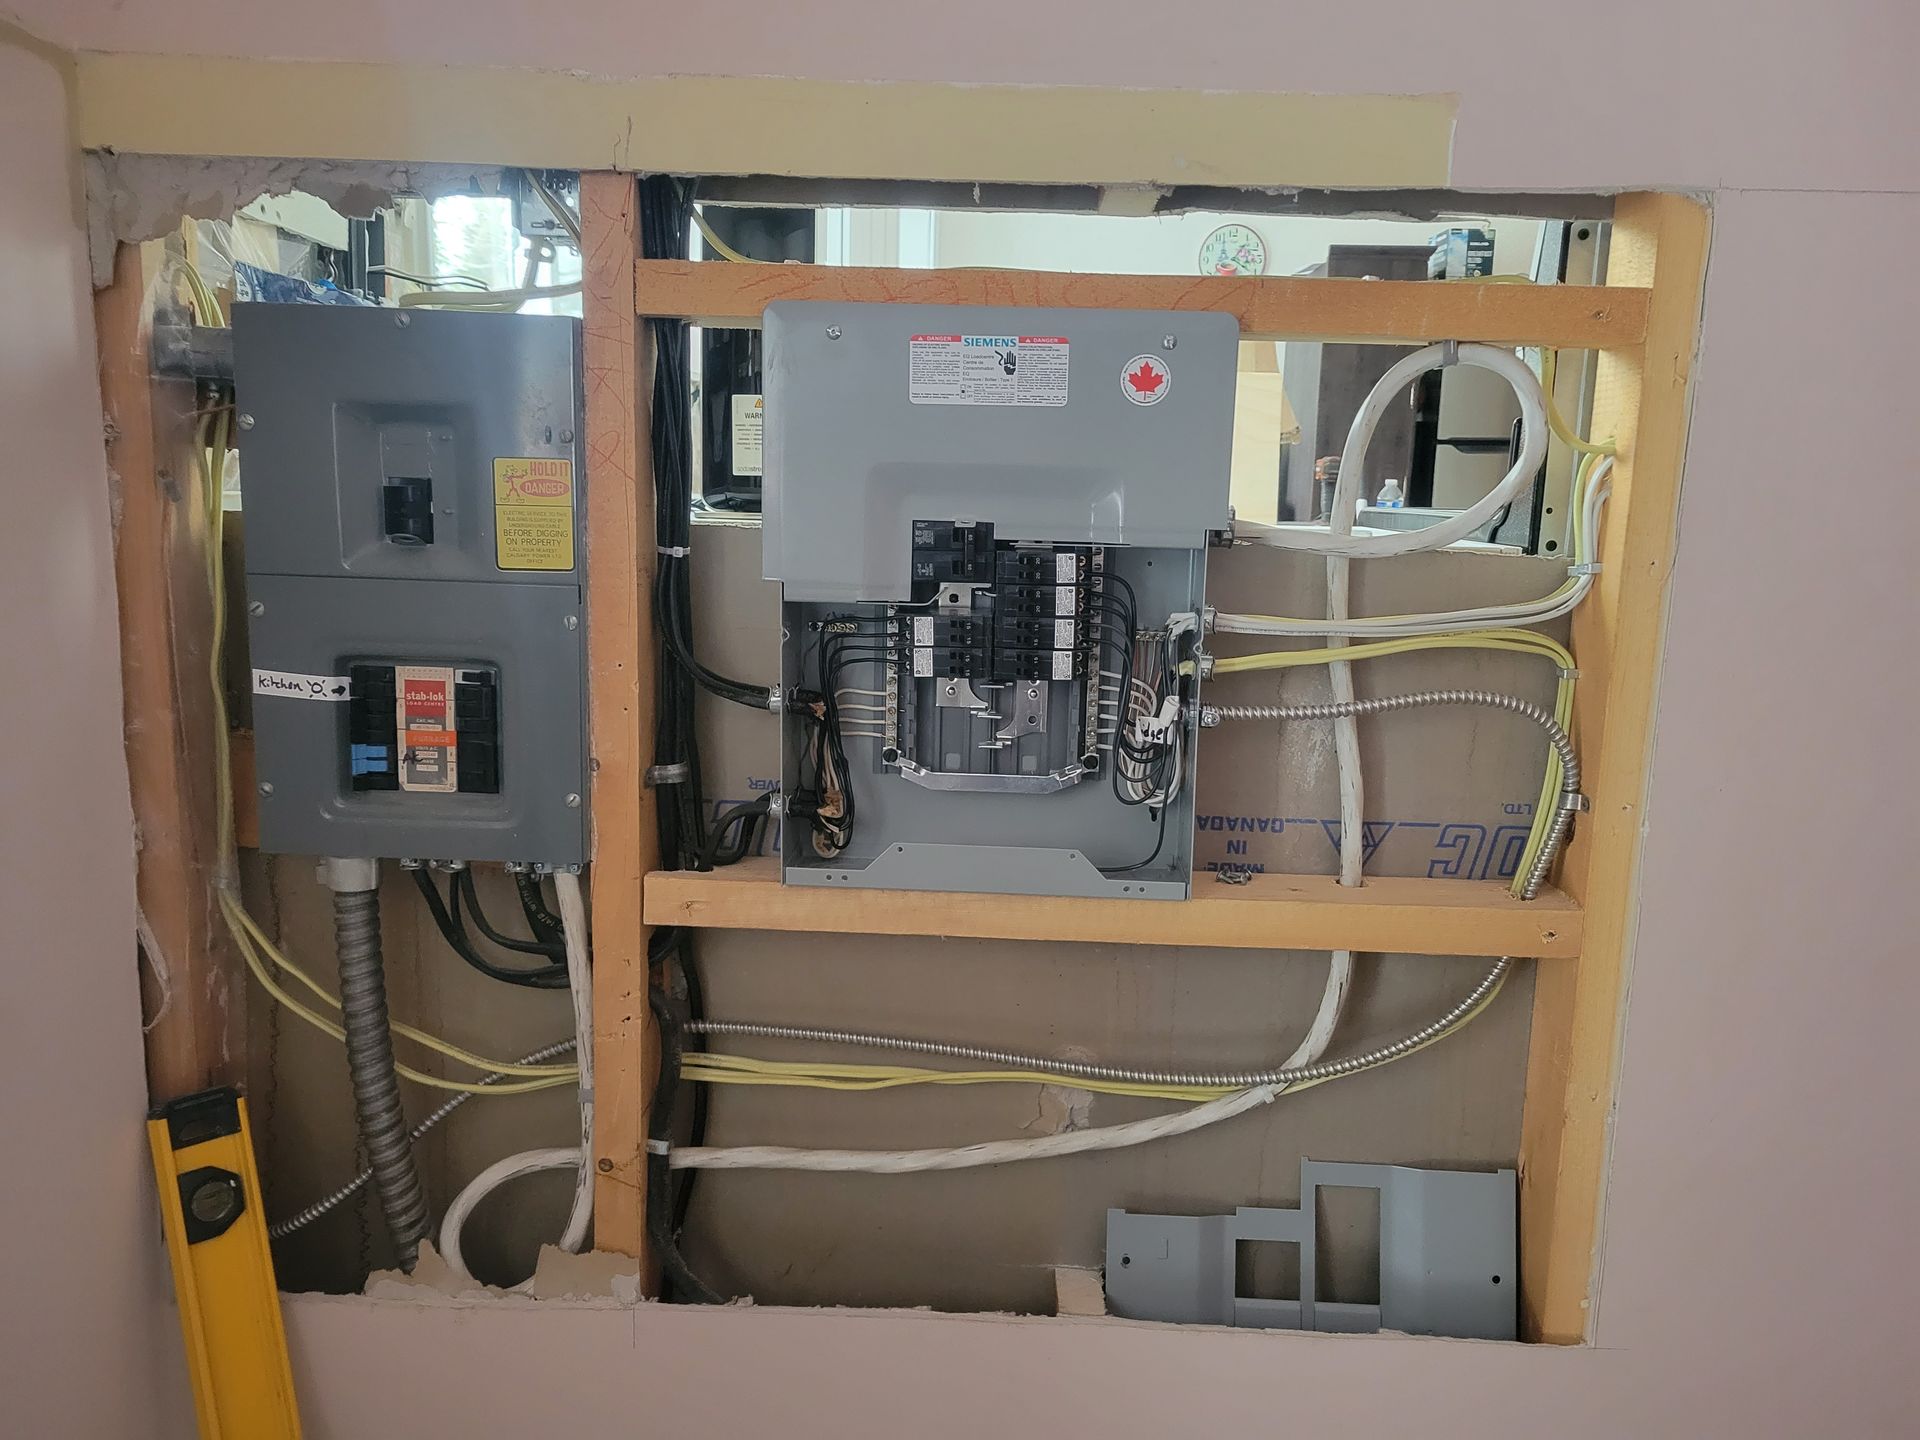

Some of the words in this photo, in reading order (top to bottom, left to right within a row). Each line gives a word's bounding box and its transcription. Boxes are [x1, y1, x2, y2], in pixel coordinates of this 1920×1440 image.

[963, 337, 1017, 348] SIEMENS
[530, 461, 557, 477] HOLD
[559, 461, 569, 477] IT
[525, 482, 565, 494] DANGER
[503, 528, 533, 537] BEFORE
[536, 529, 568, 538] DIGGING
[506, 537, 518, 546] ON
[521, 538, 562, 547] PROPERTY
[1035, 557, 1040, 565] 20
[1035, 590, 1040, 598] 20
[1035, 605, 1040, 613] 20
[406, 691, 444, 701] stab-lok
[1501, 803, 1532, 815] LTD.
[1196, 814, 1284, 834] CANADA
[1226, 839, 1247, 855] IN
